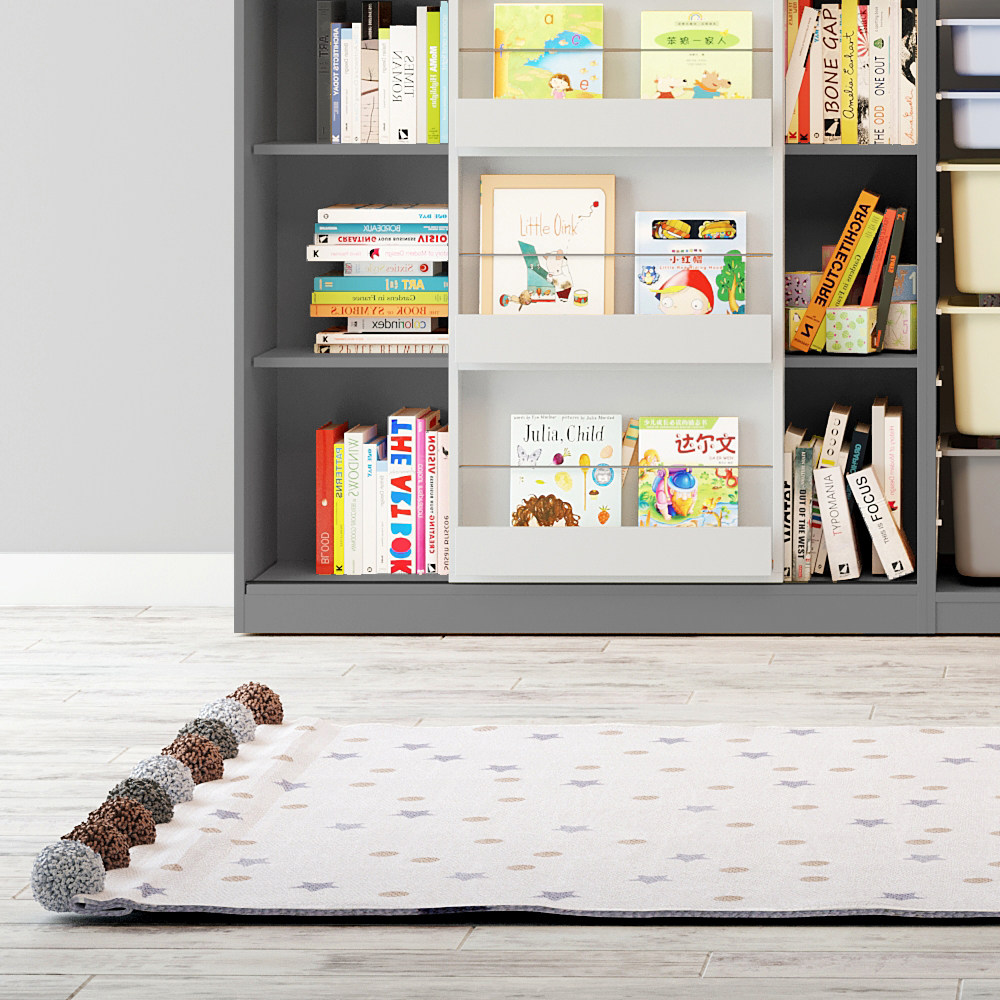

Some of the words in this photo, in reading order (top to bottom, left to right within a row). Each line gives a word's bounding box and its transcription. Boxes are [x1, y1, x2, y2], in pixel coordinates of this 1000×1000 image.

[544, 13, 554, 25] a
[822, 8, 838, 50] GAP
[571, 34, 581, 46] c
[874, 56, 885, 74] OUT
[579, 79, 589, 91] e
[824, 58, 840, 113] BONE
[874, 73, 885, 96] ONE
[842, 78, 855, 119] Amelia
[874, 105, 885, 125] ODD
[788, 131, 797, 139] K
[800, 133, 808, 141] K
[874, 129, 884, 144] THE
[520, 214, 550, 236] Little
[553, 213, 579, 236] Oink
[523, 424, 564, 443] Julia,
[566, 425, 605, 442] Child
[675, 433, 736, 454] 达尔文
[799, 489, 807, 505] OUT
[824, 474, 842, 537] TYPOMANIA
[856, 476, 882, 522] FOCUS
[799, 507, 806, 518] OF
[798, 519, 806, 534] THE
[797, 536, 805, 559] WEST
